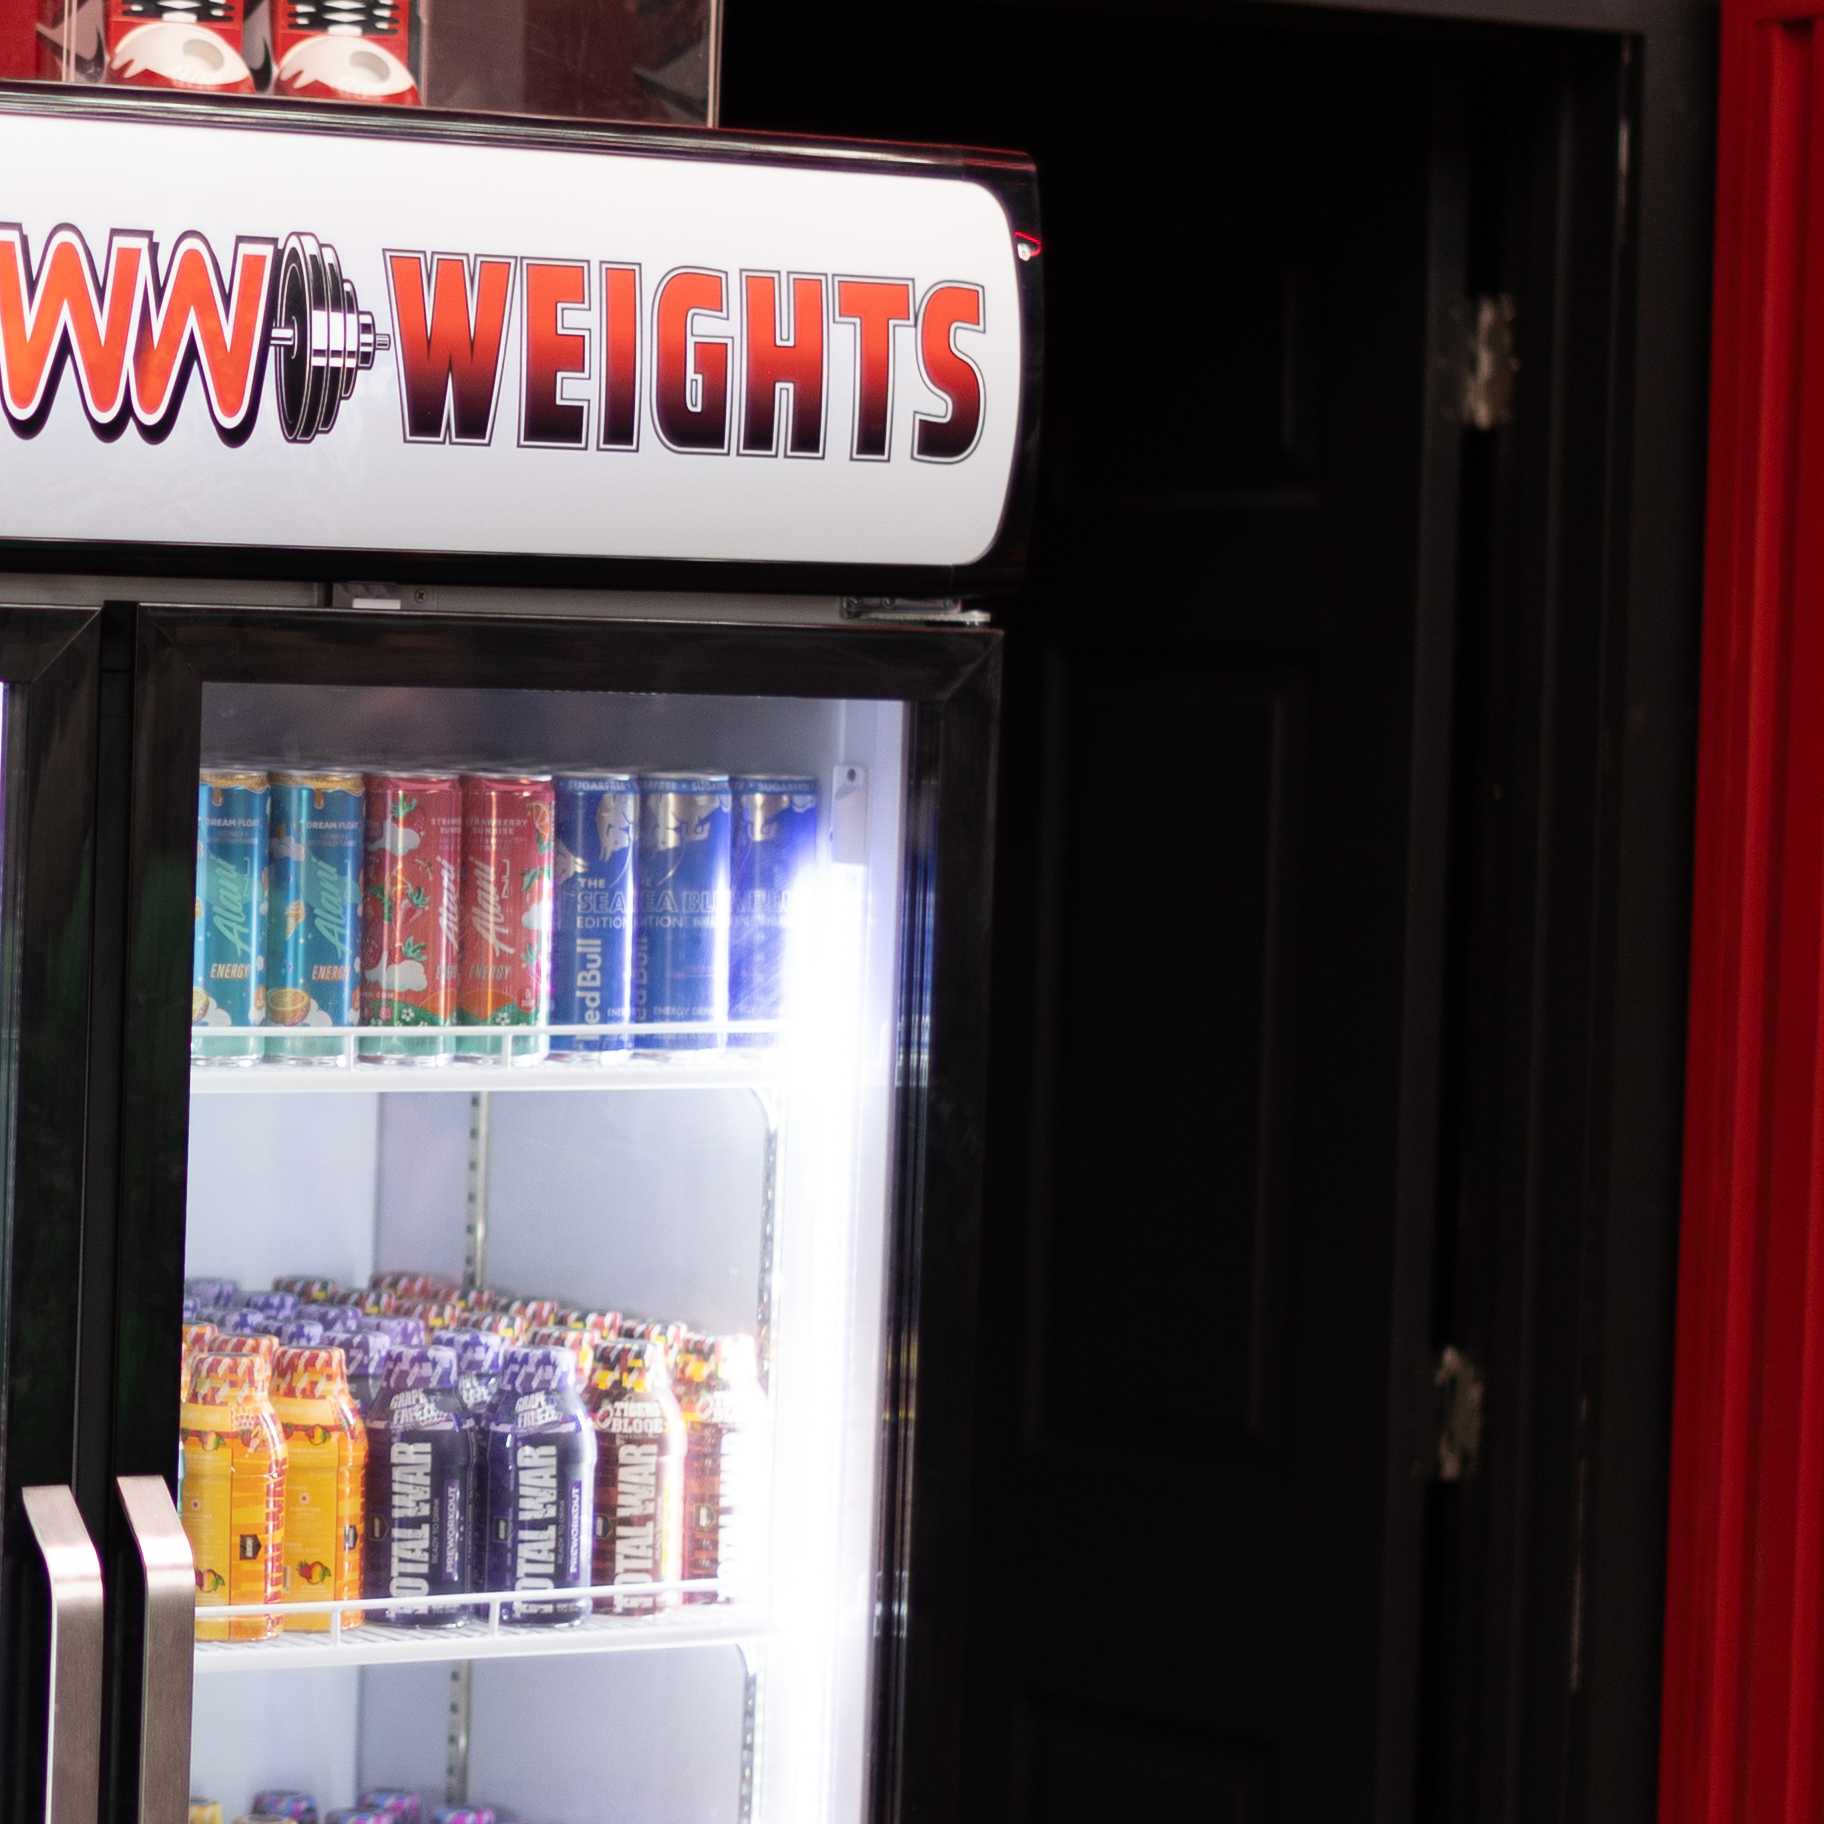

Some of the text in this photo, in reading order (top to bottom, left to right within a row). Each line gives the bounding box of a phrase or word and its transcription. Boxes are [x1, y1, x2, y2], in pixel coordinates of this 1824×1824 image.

[382, 248, 987, 464] WEIGHTS
[576, 890, 626, 914] SEA
[579, 878, 606, 889] THE
[210, 963, 250, 980] ENERGY
[577, 939, 602, 988] Bull
[390, 1441, 433, 1520] WAR
[516, 1444, 558, 1522] WAR
[616, 1443, 658, 1519] WAR
